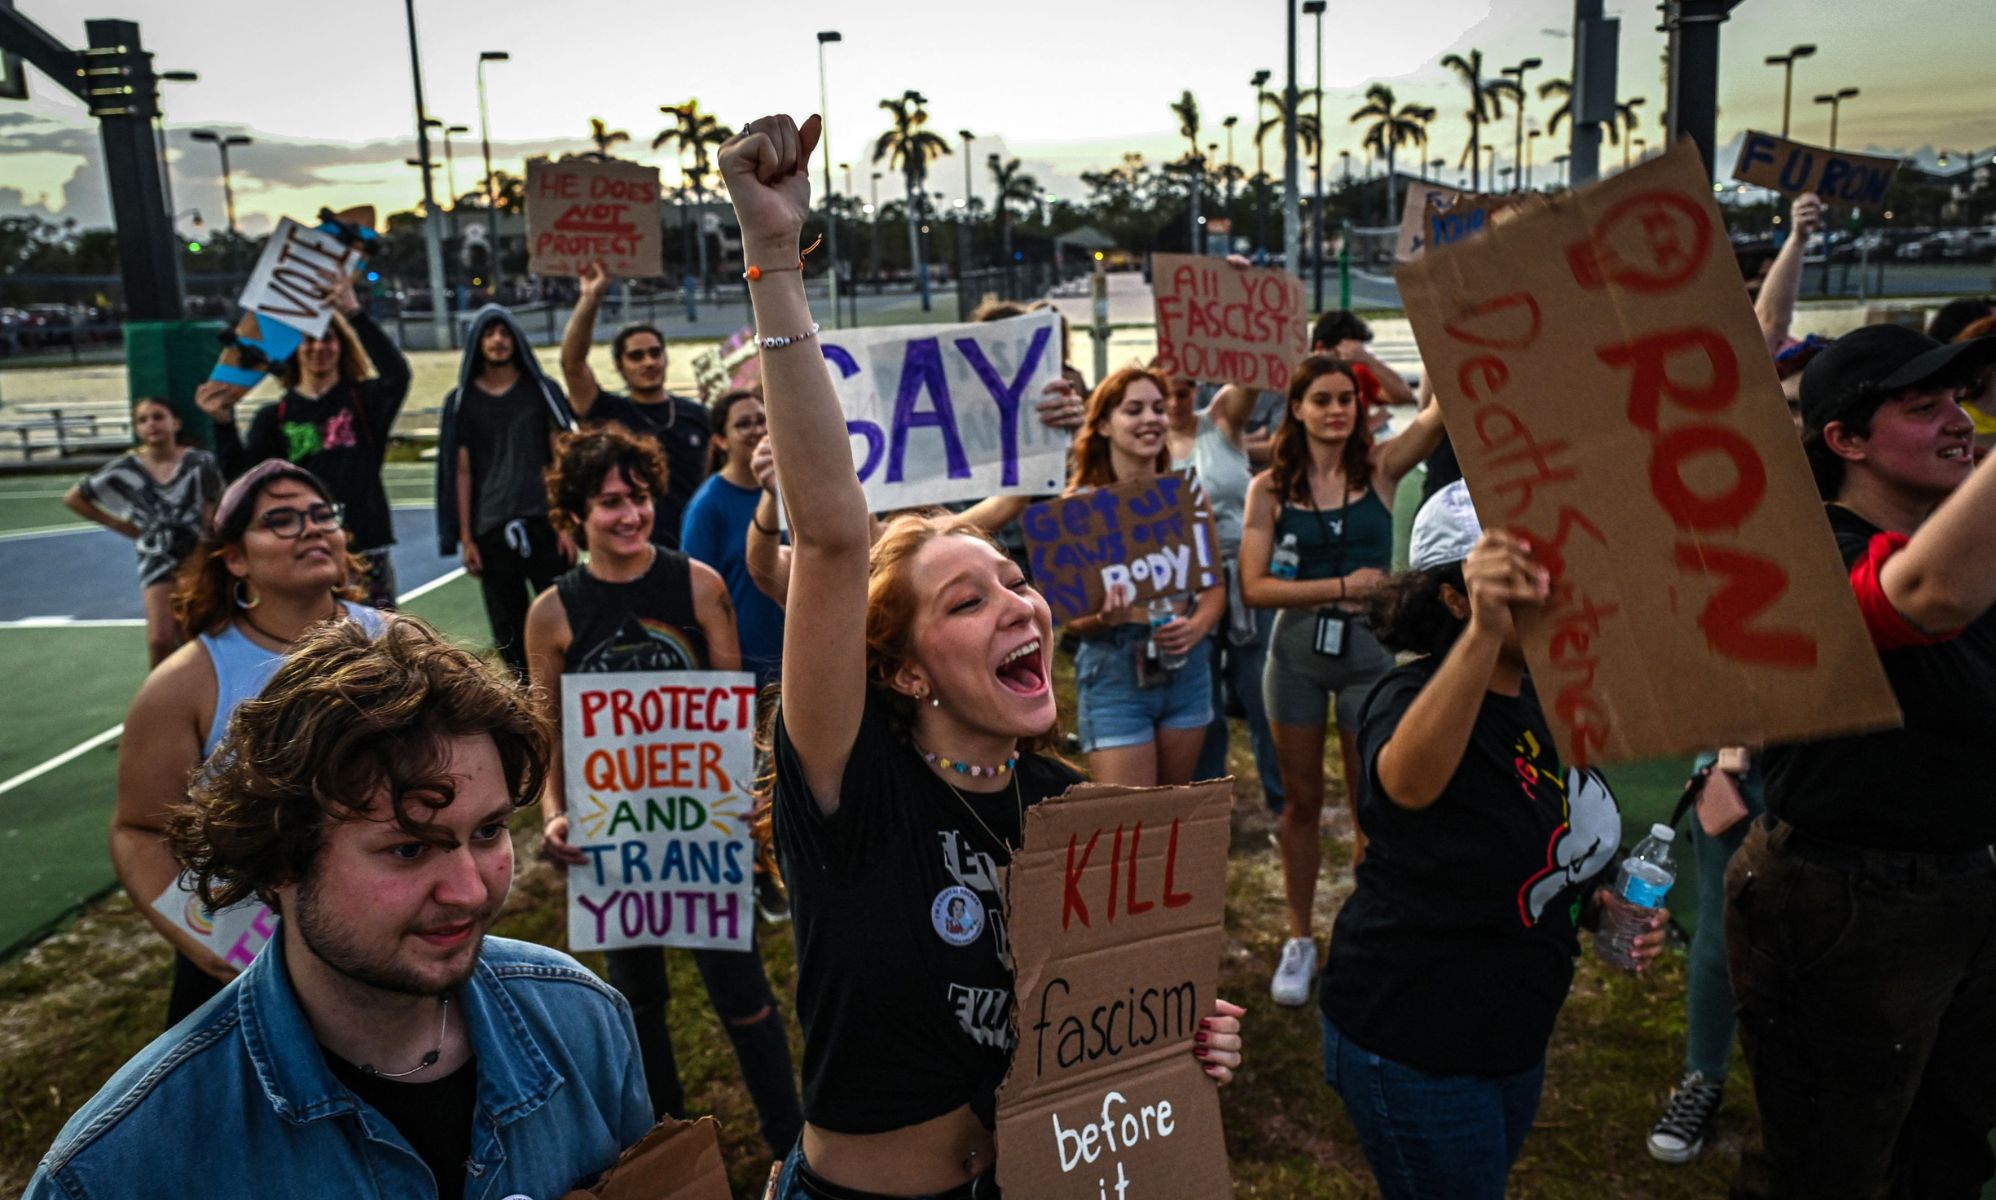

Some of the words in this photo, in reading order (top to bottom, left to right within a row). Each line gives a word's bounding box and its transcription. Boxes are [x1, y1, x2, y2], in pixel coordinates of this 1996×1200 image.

[540, 172, 580, 199] HE
[590, 174, 655, 204] DOES
[560, 203, 631, 224] NOT
[536, 232, 644, 256] PROTECT
[256, 225, 350, 319] VOTE
[1157, 336, 1259, 385] BOUND
[1260, 353, 1289, 390] TO
[1444, 292, 1577, 521] Death
[1595, 326, 1818, 670] RON
[580, 686, 757, 738] PROTECT
[583, 742, 731, 793] QUEER
[607, 795, 707, 836] AND
[580, 839, 744, 886] TRANS
[1062, 817, 1193, 932] KILL
[577, 889, 739, 944] YOUTH
[1033, 977, 1197, 1077] fascism
[1052, 1091, 1175, 1173] before
[1099, 1161, 1130, 1200] it
